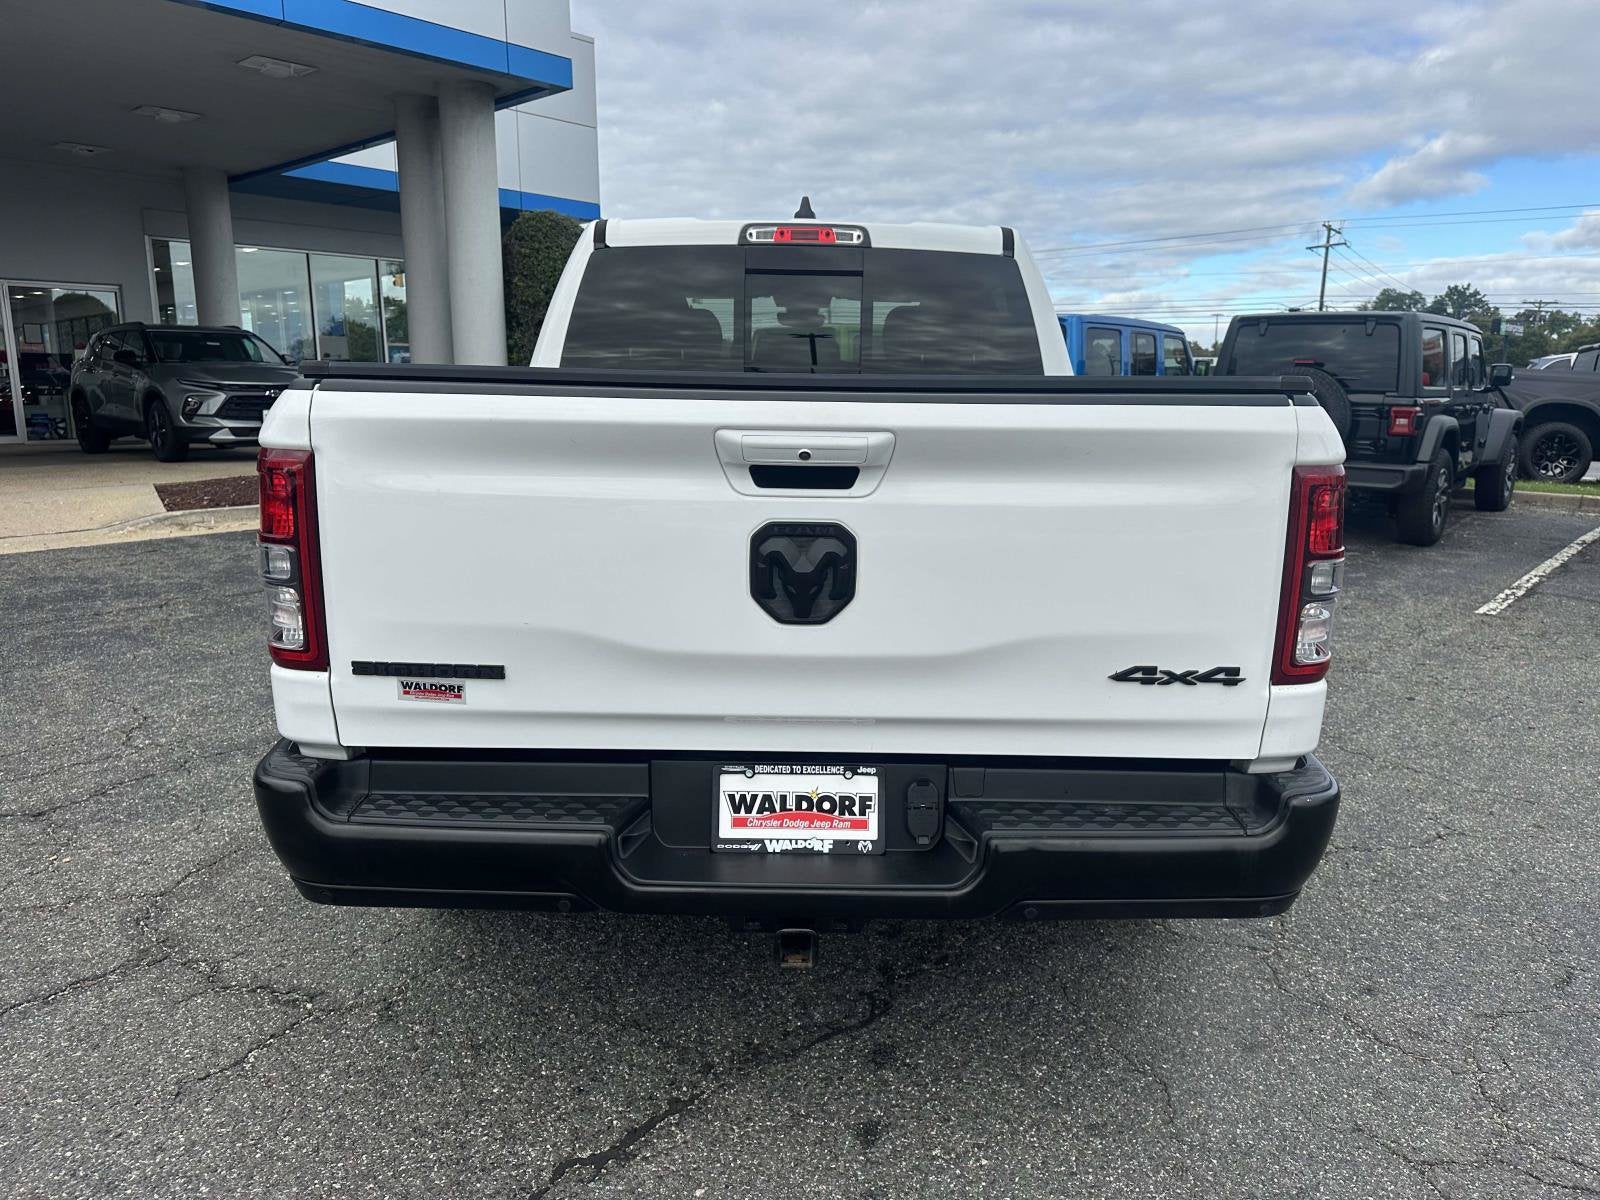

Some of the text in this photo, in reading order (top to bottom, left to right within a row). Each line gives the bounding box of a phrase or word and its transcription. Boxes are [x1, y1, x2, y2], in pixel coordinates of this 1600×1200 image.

[1107, 665, 1247, 686] 4x4
[400, 680, 464, 694] WALDORF
[754, 765, 791, 774] DEDICATED
[792, 765, 802, 774] TO
[802, 765, 845, 775] EXCELLENCE
[857, 766, 877, 775] Jeep
[726, 792, 875, 817] WALDORF
[747, 818, 851, 829] Chrysler Dodge Jeep Ram
[764, 838, 834, 854] WALDORF
